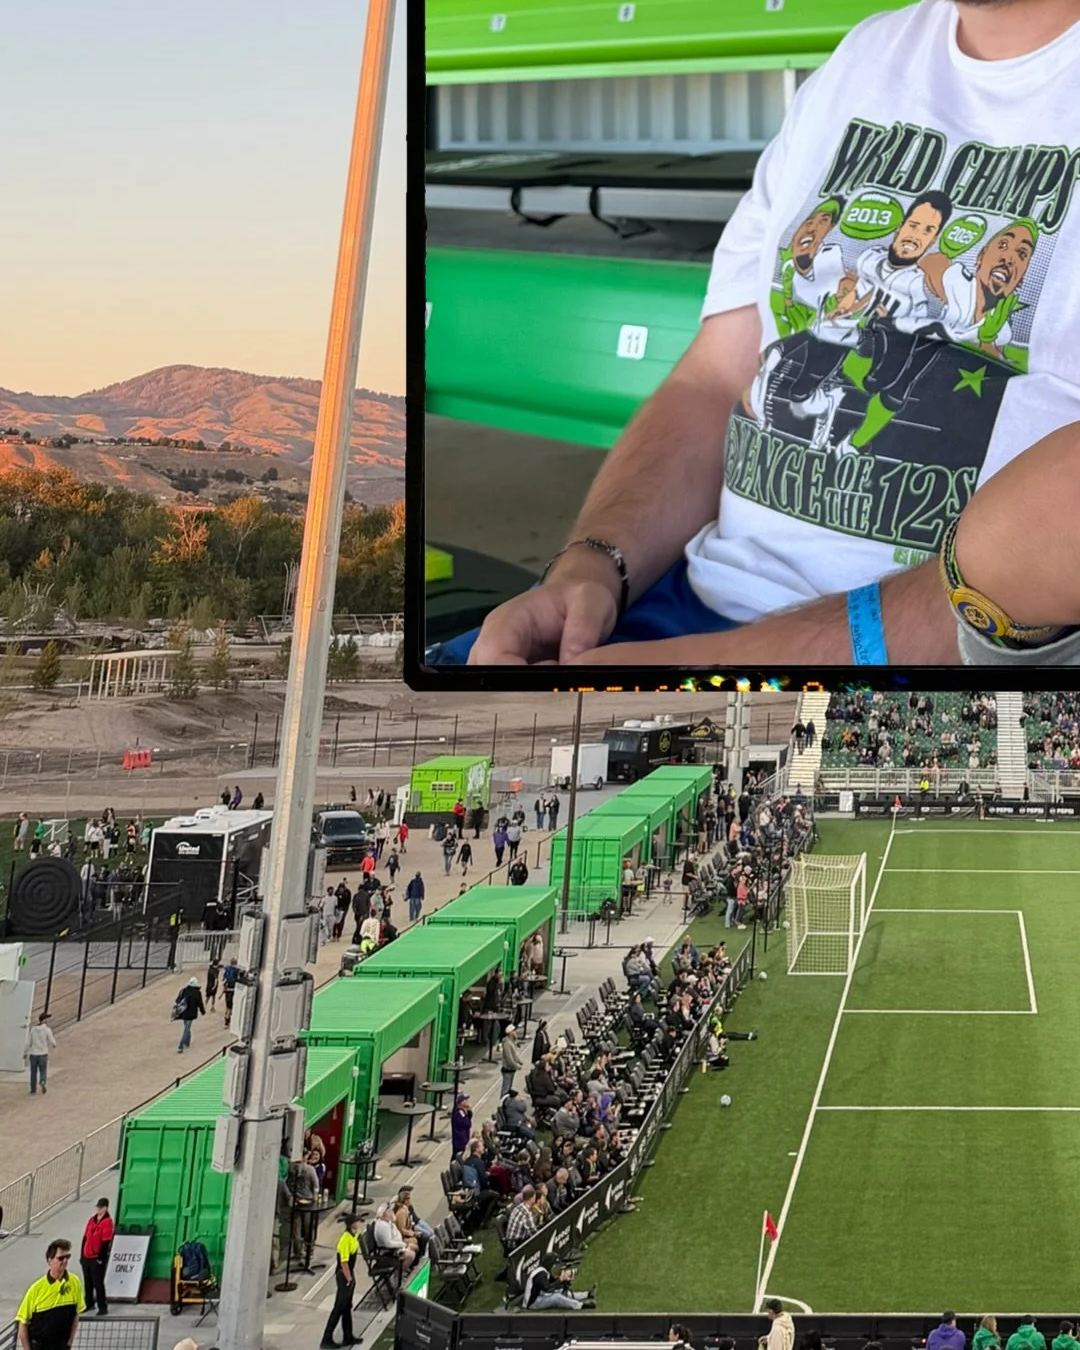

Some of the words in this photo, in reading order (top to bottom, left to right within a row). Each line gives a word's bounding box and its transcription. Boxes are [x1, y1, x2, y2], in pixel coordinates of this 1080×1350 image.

[846, 207, 892, 226] 2013
[835, 453, 876, 493] OF
[825, 488, 873, 534] THE
[112, 1252, 142, 1263] SUITES
[115, 1264, 135, 1274] ONLY
